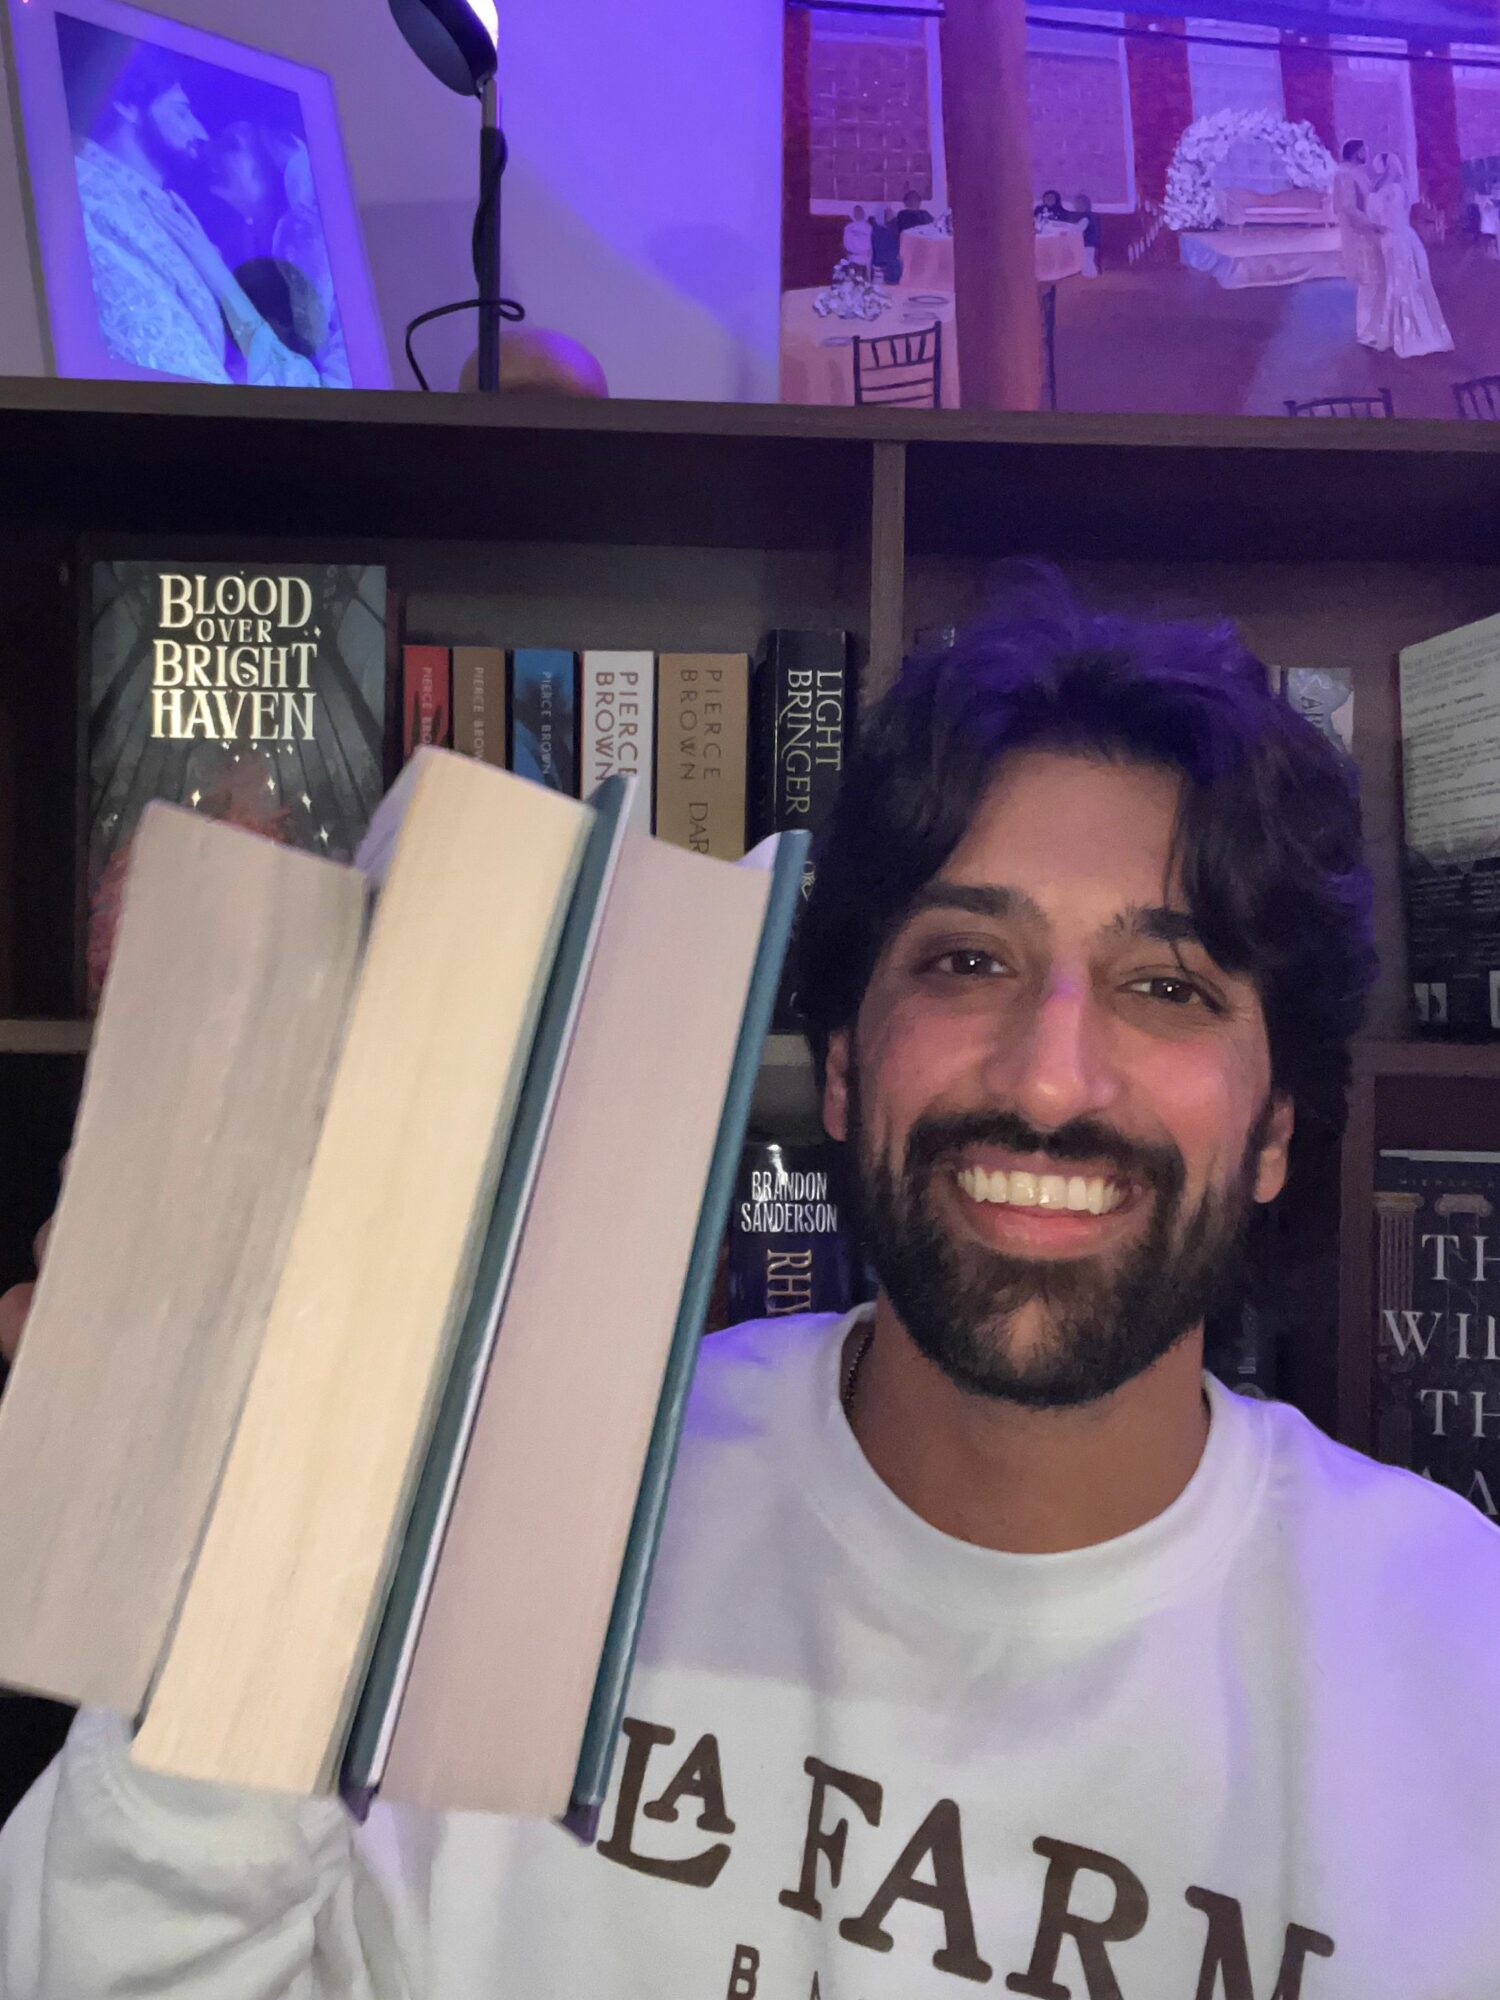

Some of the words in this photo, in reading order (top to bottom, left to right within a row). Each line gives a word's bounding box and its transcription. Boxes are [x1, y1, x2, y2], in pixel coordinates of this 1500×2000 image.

[158, 573, 312, 629] BLOOD
[195, 618, 272, 643] OVER
[152, 638, 318, 688] BRIGHT
[421, 666, 433, 710] PIERCE
[150, 688, 317, 741] HAVEN
[472, 666, 485, 713] PIERCE
[540, 671, 553, 717] PIERCE
[594, 671, 616, 782] BROWN
[679, 668, 699, 780] BROWN
[703, 668, 723, 779] PIERCE
[779, 668, 813, 816] BRINGER
[815, 669, 843, 771] LIGHT
[540, 724, 553, 775] BROWN
[751, 1170, 828, 1201] BRANDON
[740, 1202, 838, 1233] SANDERSON
[597, 1716, 735, 1888] LA
